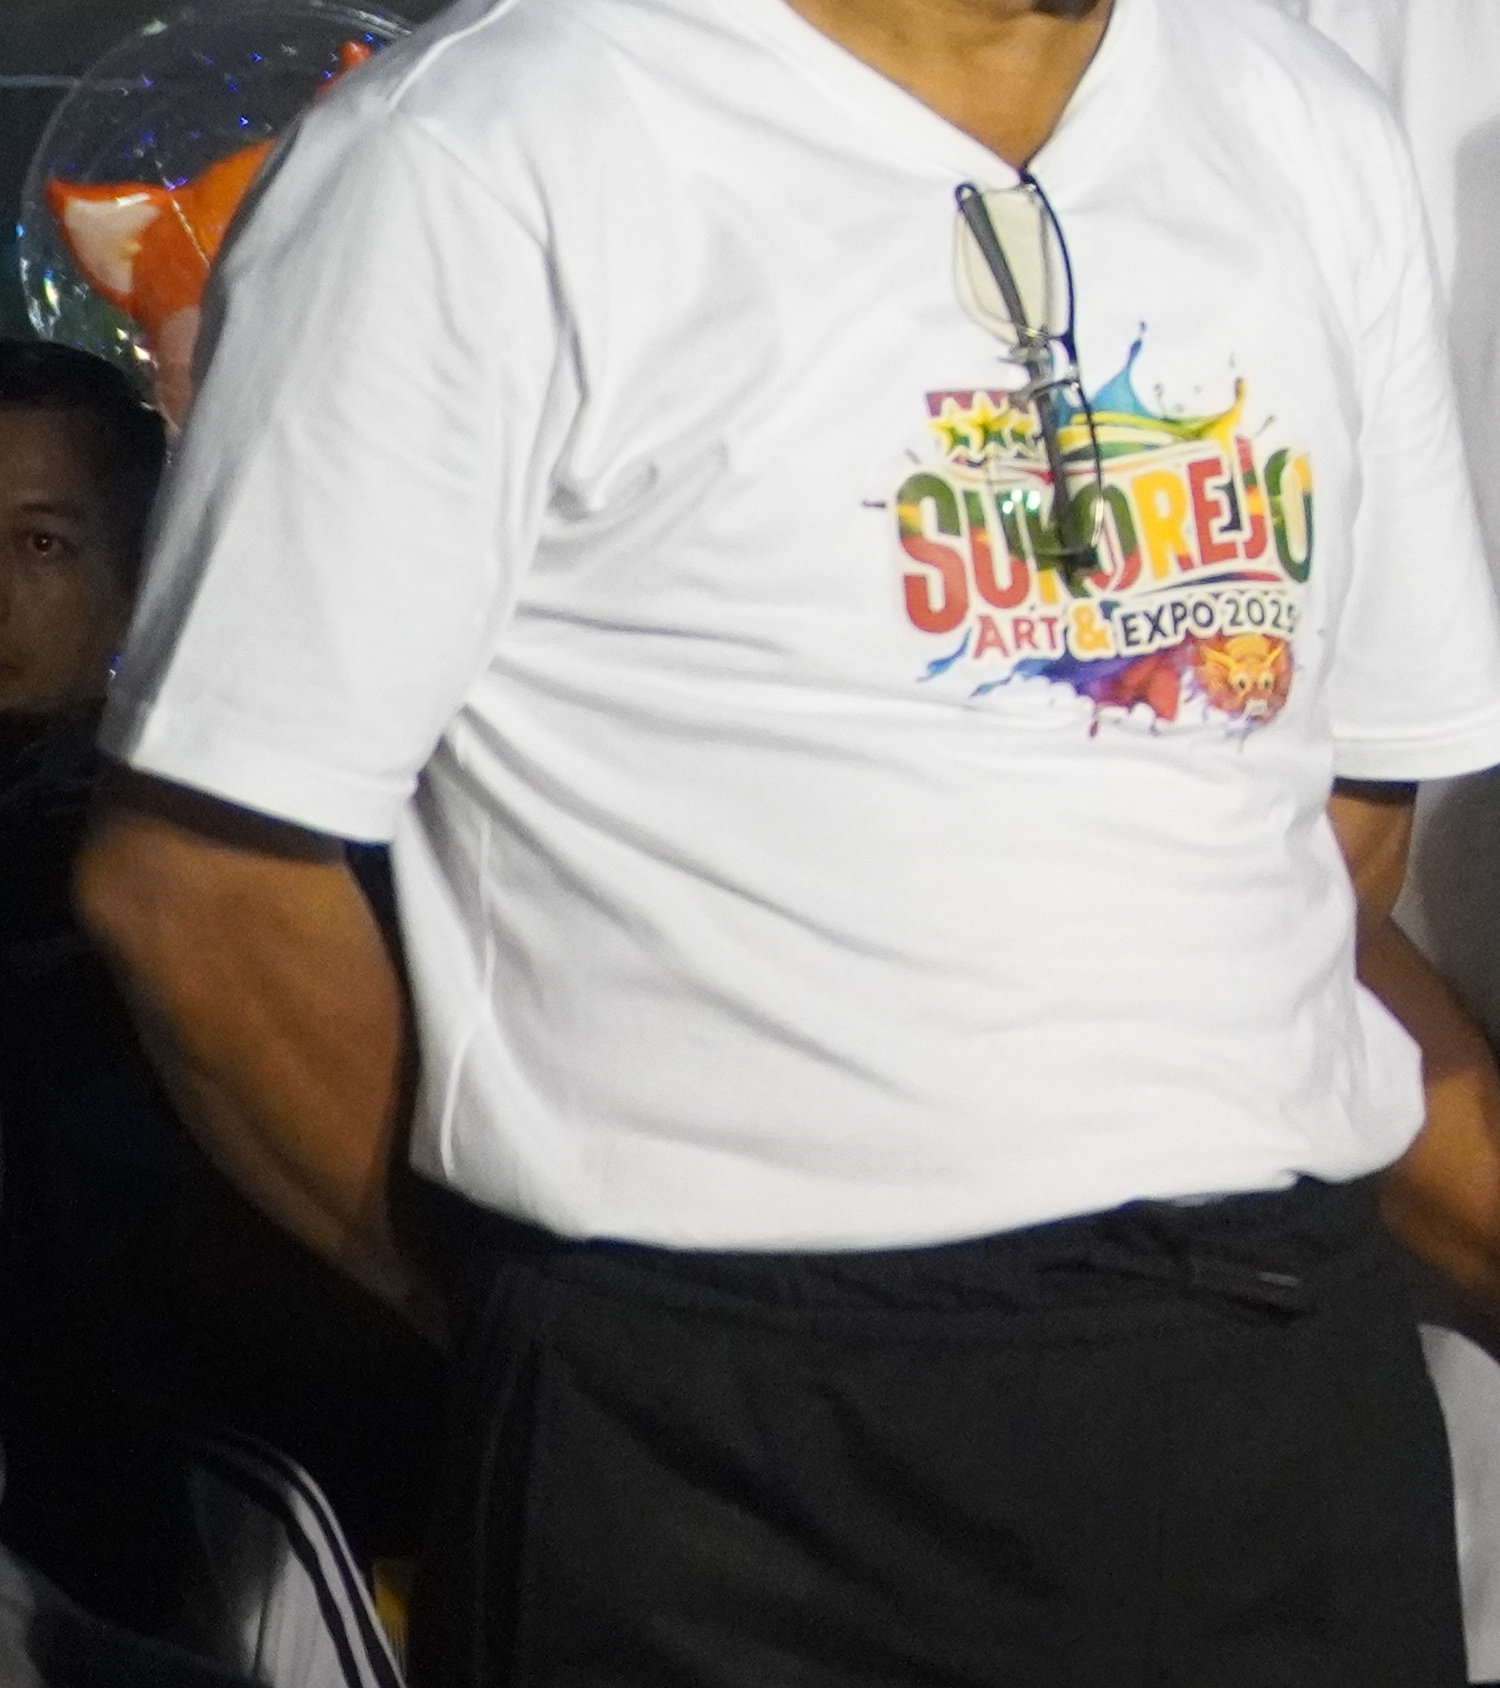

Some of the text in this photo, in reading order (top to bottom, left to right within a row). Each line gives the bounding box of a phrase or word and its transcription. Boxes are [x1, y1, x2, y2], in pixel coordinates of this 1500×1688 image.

[896, 437, 1314, 634] SUKOREJO
[973, 615, 1058, 660] ART
[1071, 604, 1113, 652] &
[1121, 601, 1215, 647] EXPO
